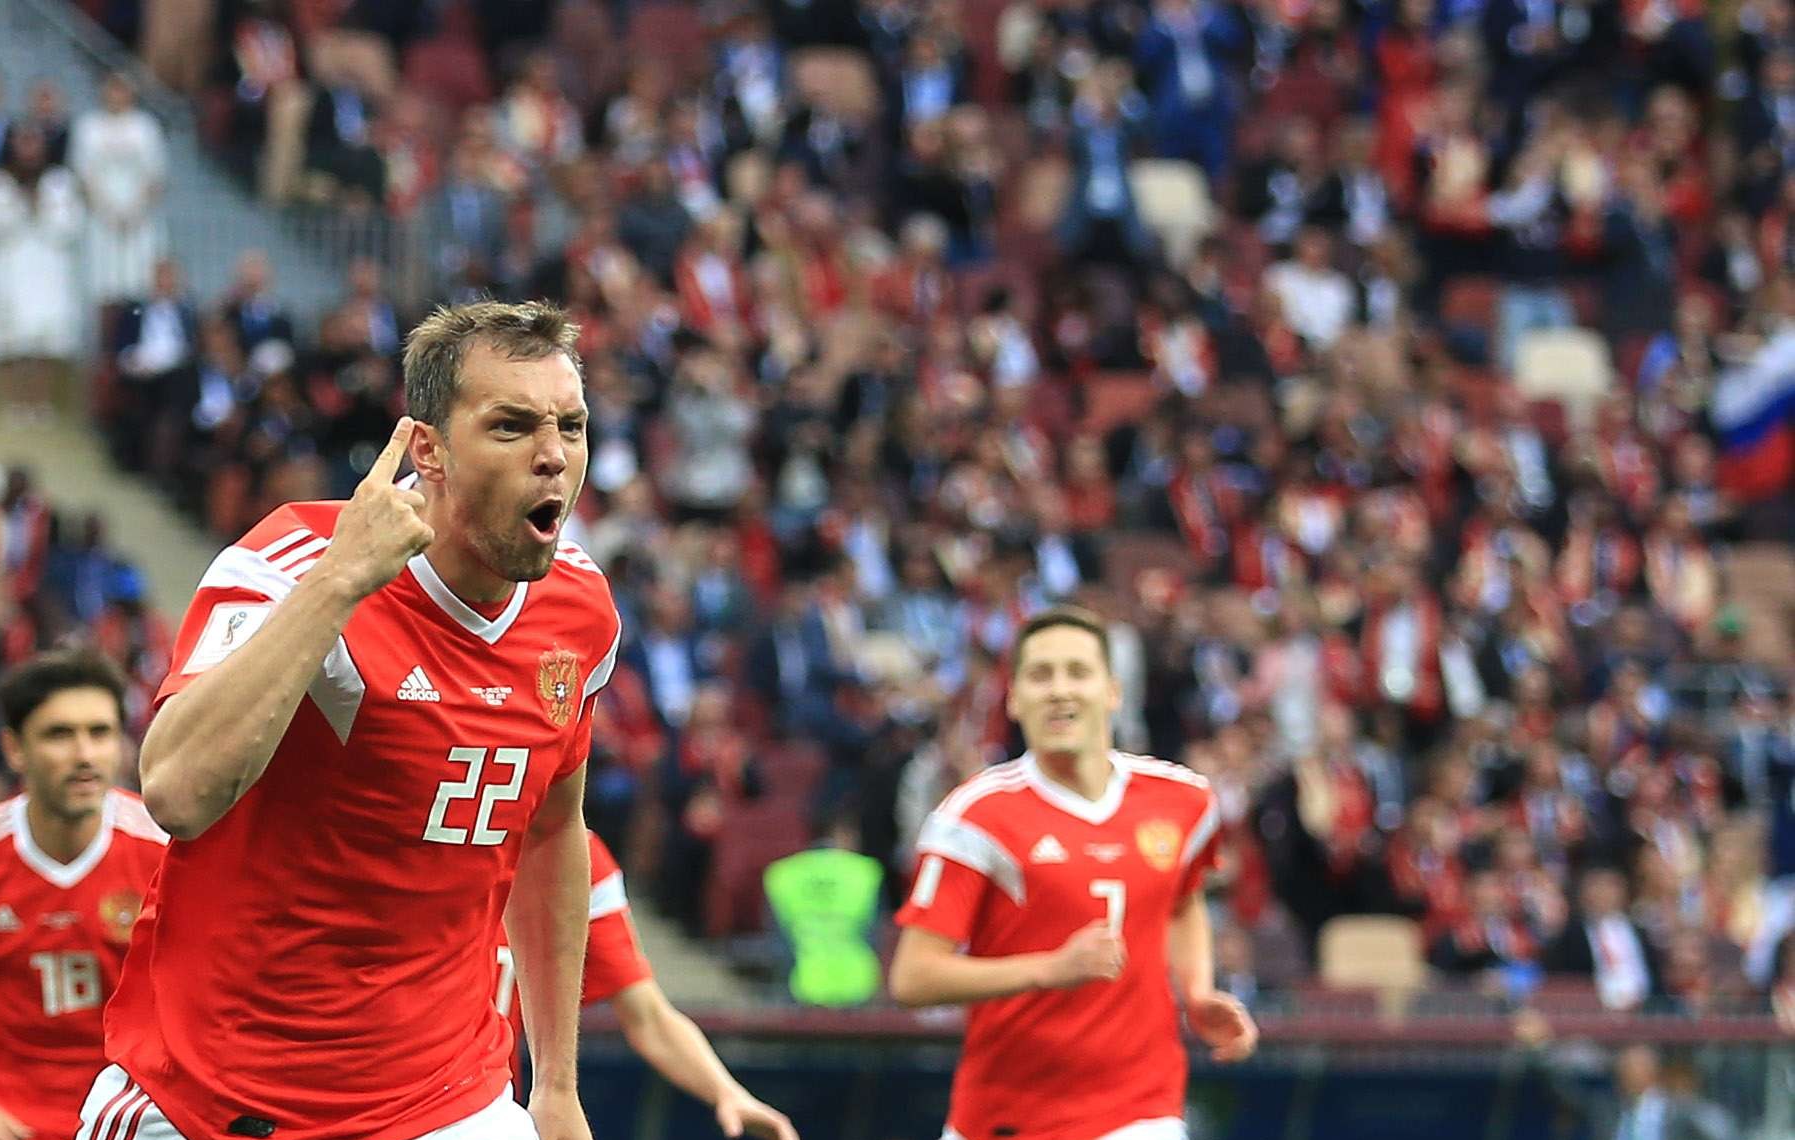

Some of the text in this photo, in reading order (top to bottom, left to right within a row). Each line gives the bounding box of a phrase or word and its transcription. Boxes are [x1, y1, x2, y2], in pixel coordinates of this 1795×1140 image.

[397, 689, 441, 702] adidas
[422, 747, 529, 845] 22
[29, 952, 102, 1017] 18
